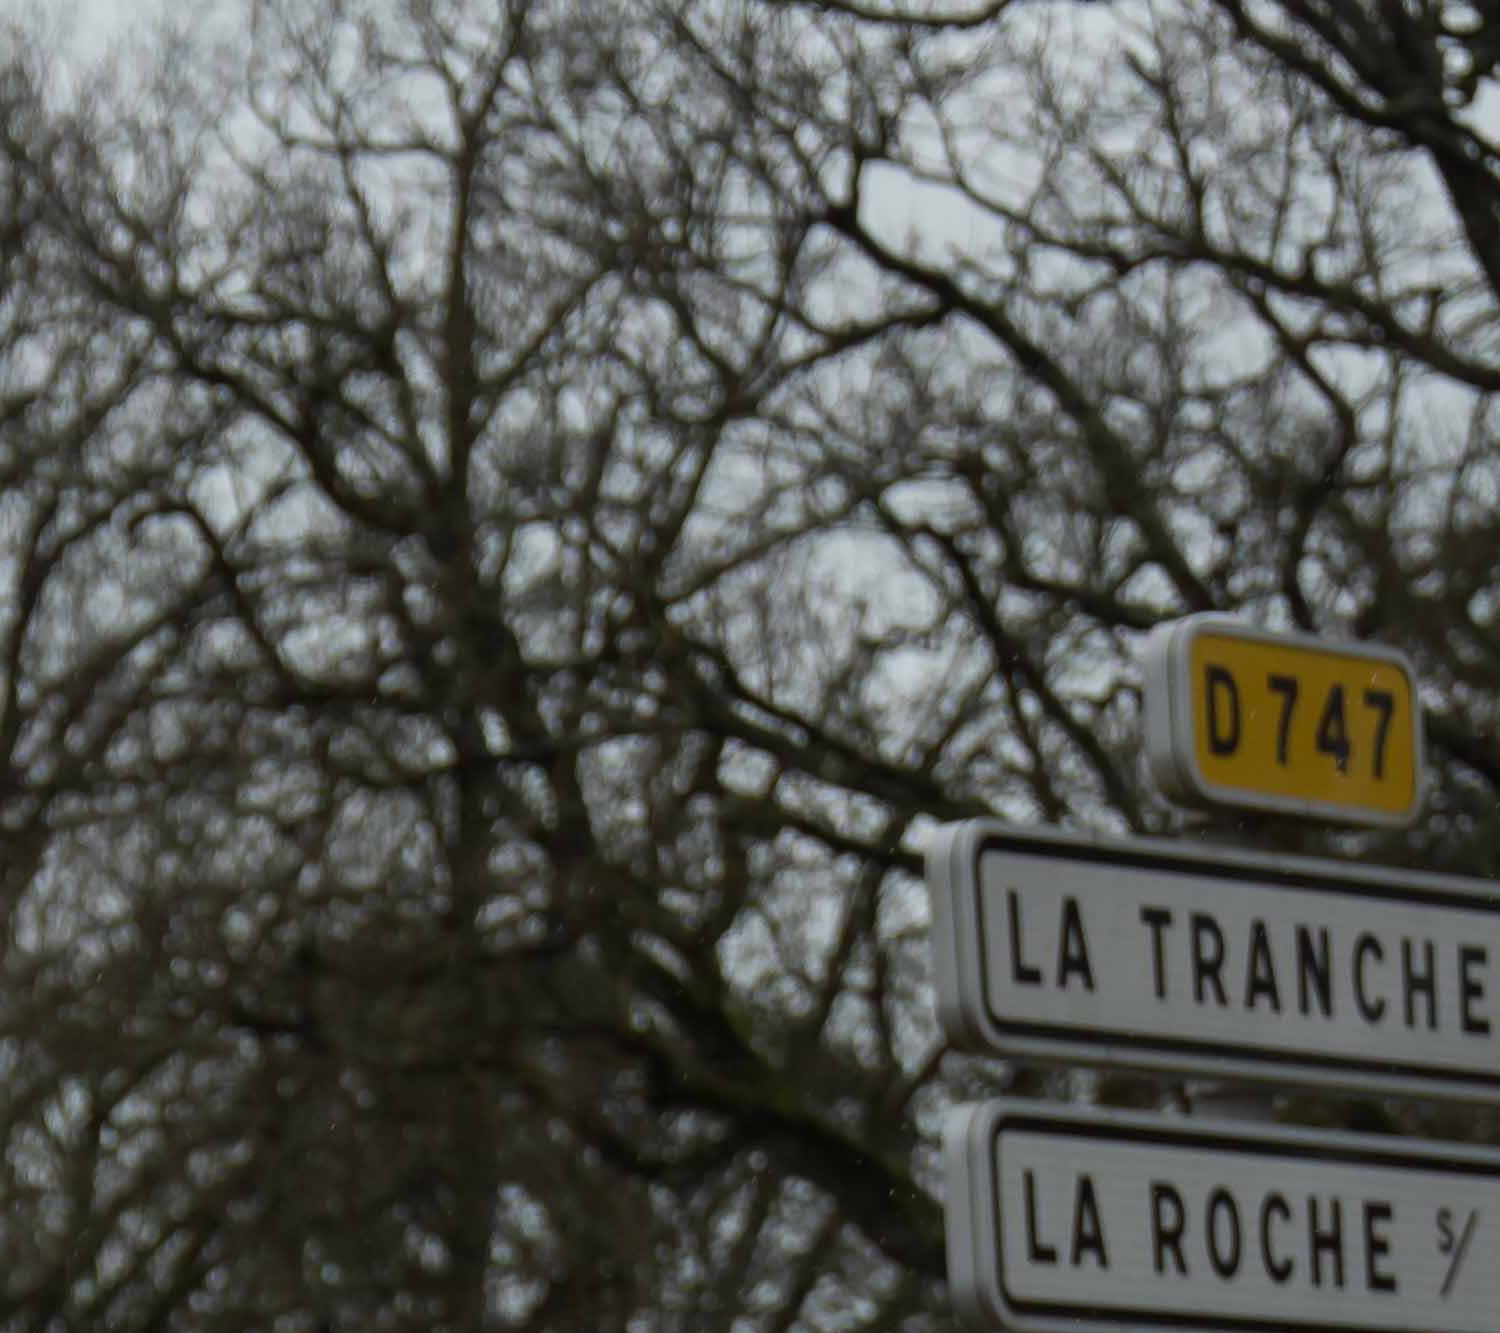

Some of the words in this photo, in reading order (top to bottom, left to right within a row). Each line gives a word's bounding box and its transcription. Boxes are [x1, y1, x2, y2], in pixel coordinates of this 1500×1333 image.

[1205, 665, 1243, 758] D
[1268, 676, 1396, 782] 747
[1007, 889, 1094, 992] LA
[1140, 907, 1492, 1041] TRANCHE
[1023, 1169, 1108, 1272] LA
[1151, 1183, 1397, 1294] ROCHE
